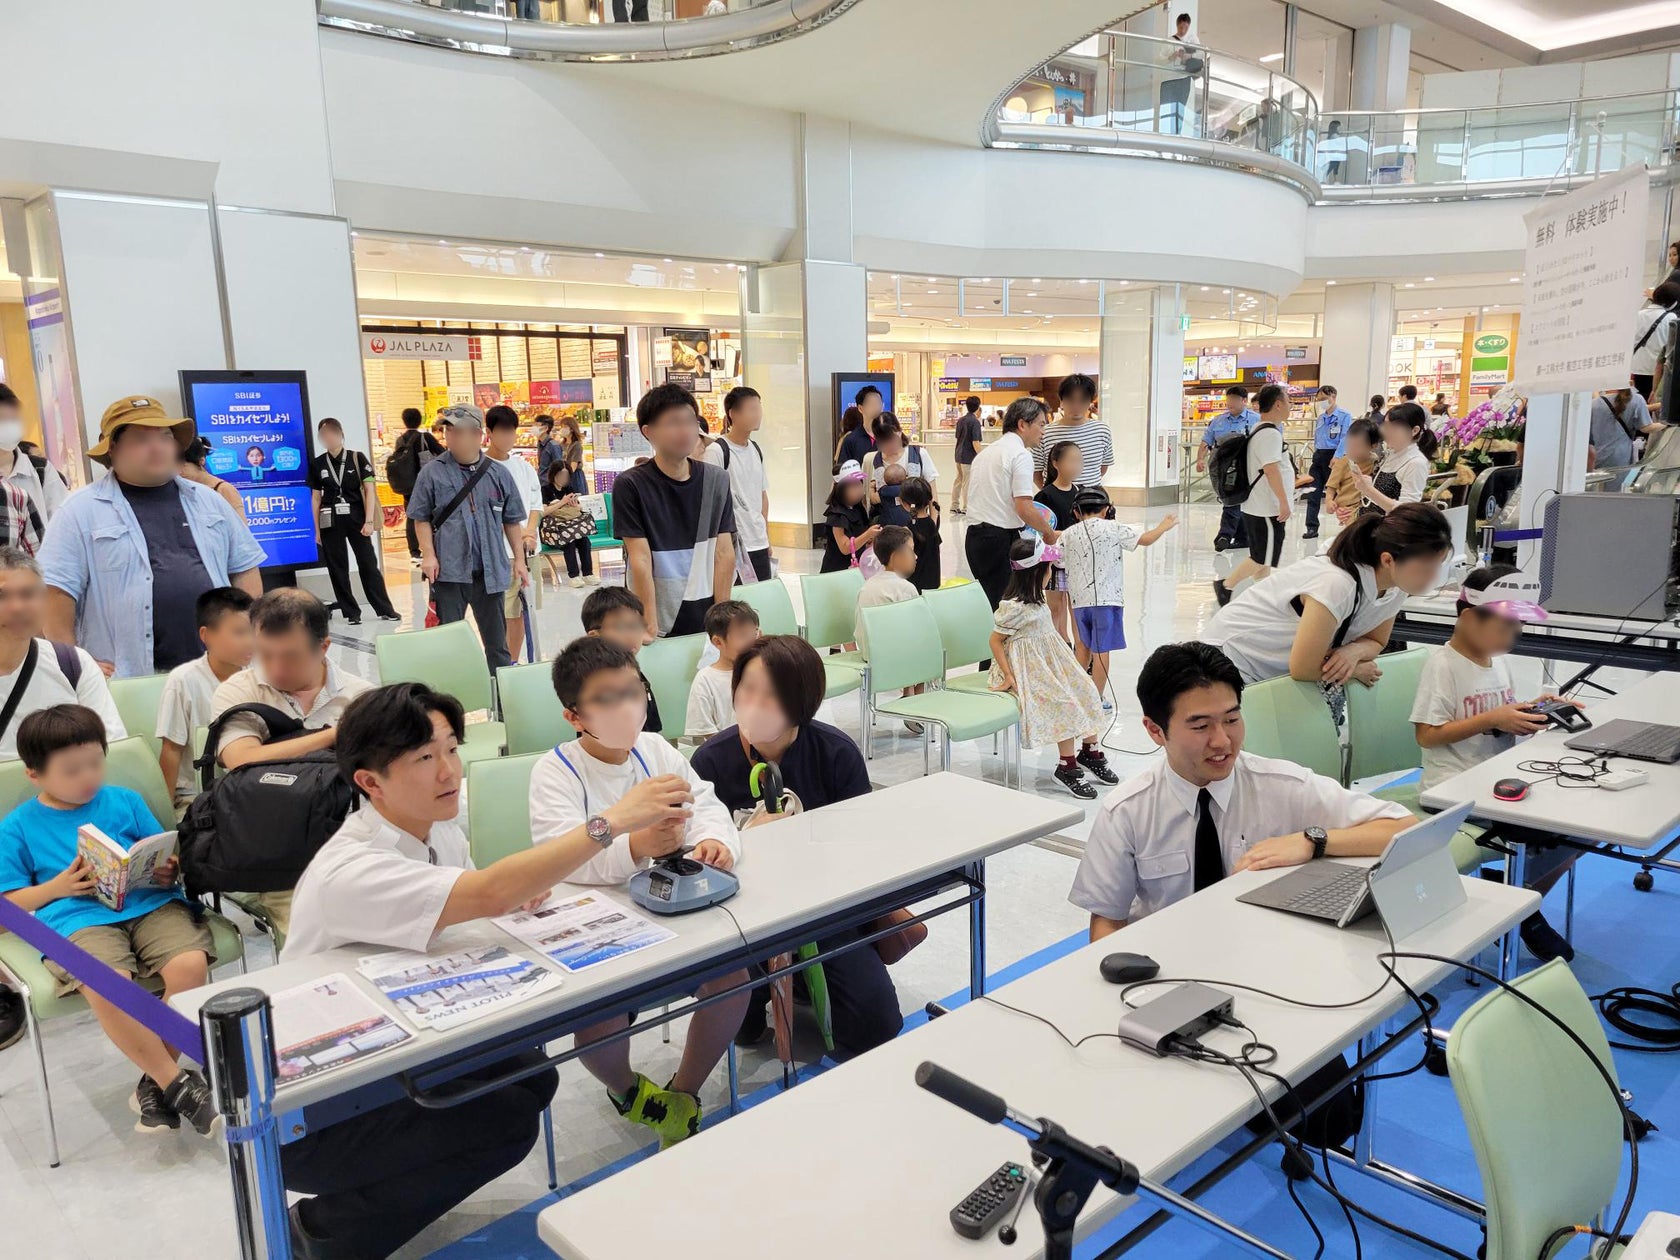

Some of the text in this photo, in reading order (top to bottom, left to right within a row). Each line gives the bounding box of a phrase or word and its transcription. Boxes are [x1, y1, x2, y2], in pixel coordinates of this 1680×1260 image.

[389, 341, 453, 352] JAL PLAZA
[1472, 373, 1506, 382] FamilyMart
[424, 991, 512, 1021] PILOT NEWS
